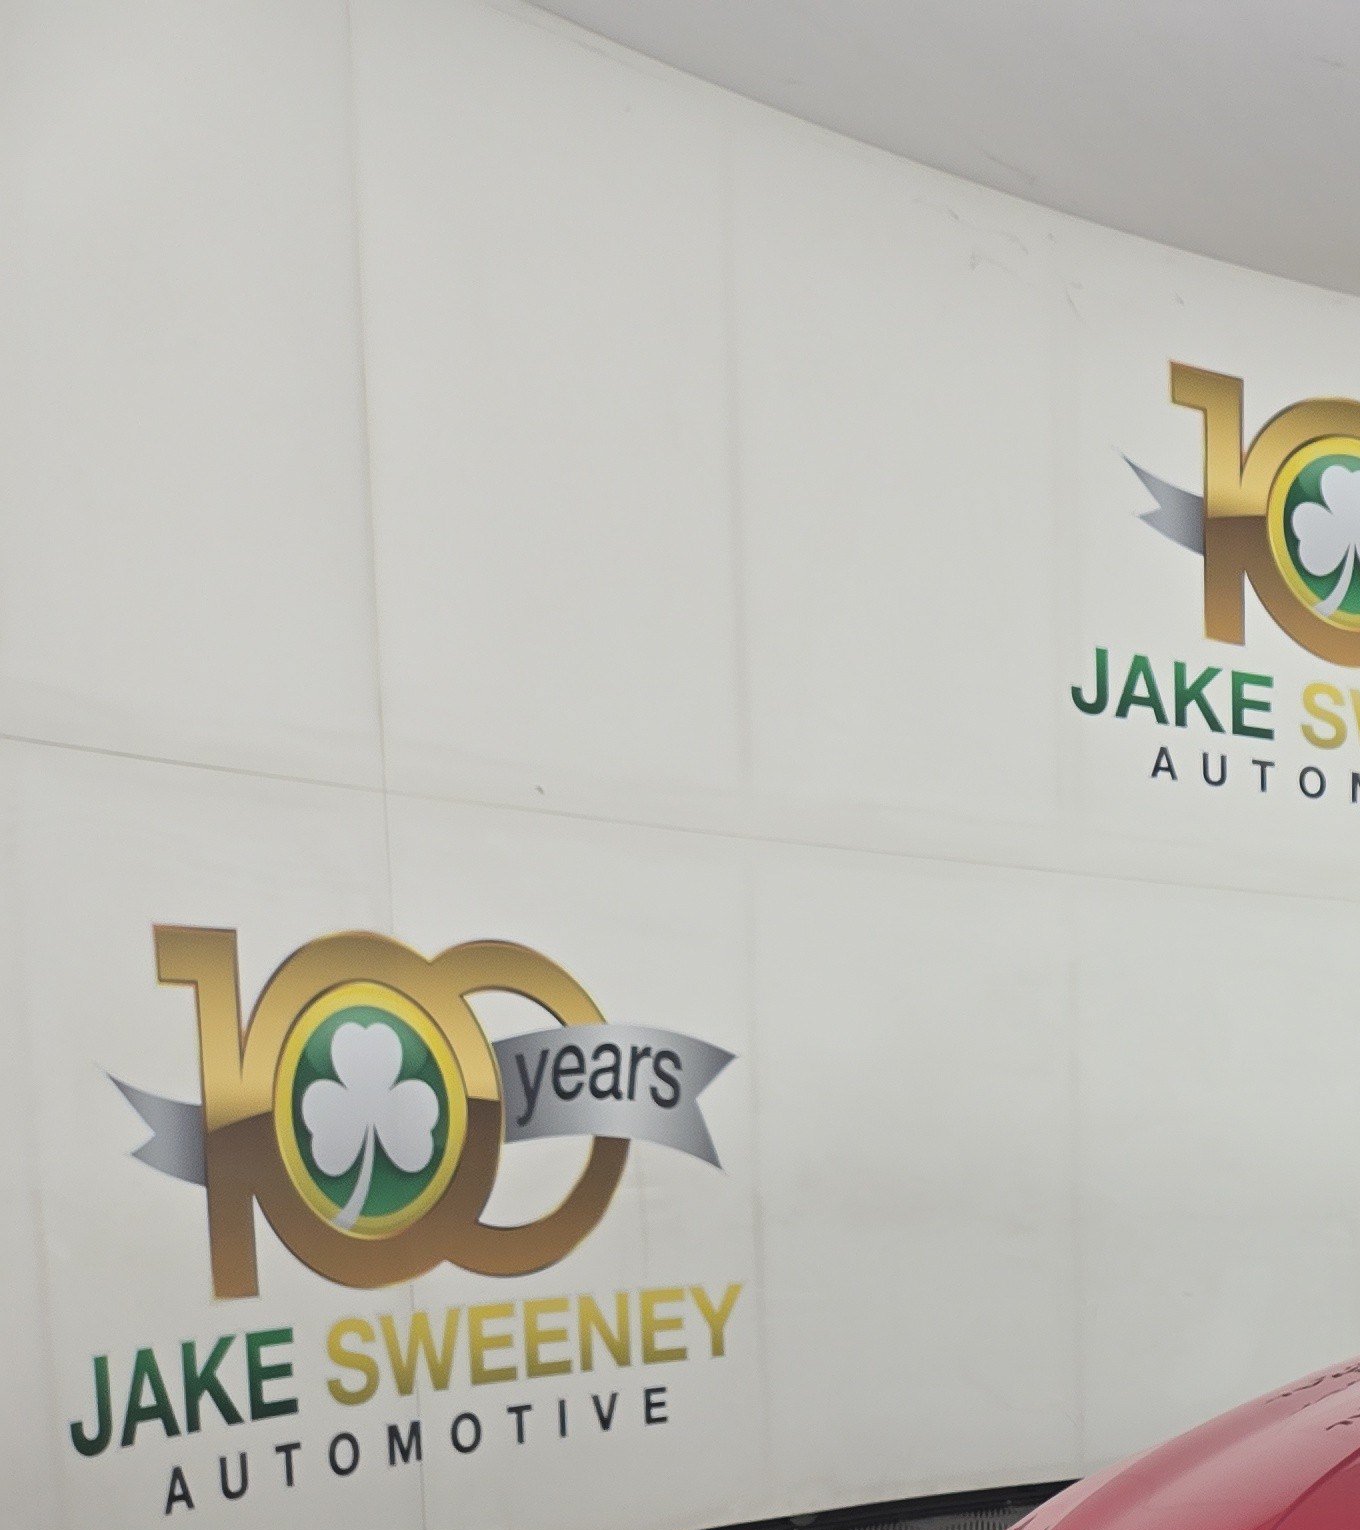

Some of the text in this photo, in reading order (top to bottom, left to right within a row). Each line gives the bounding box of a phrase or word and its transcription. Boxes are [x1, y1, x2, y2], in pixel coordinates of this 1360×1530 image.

[1070, 646, 1275, 742] JAKE
[153, 924, 631, 1299] 100
[515, 1041, 683, 1126] years
[70, 1283, 745, 1457] JAKE SWEENEY
[165, 1387, 670, 1515] AUTOMOTIVE
